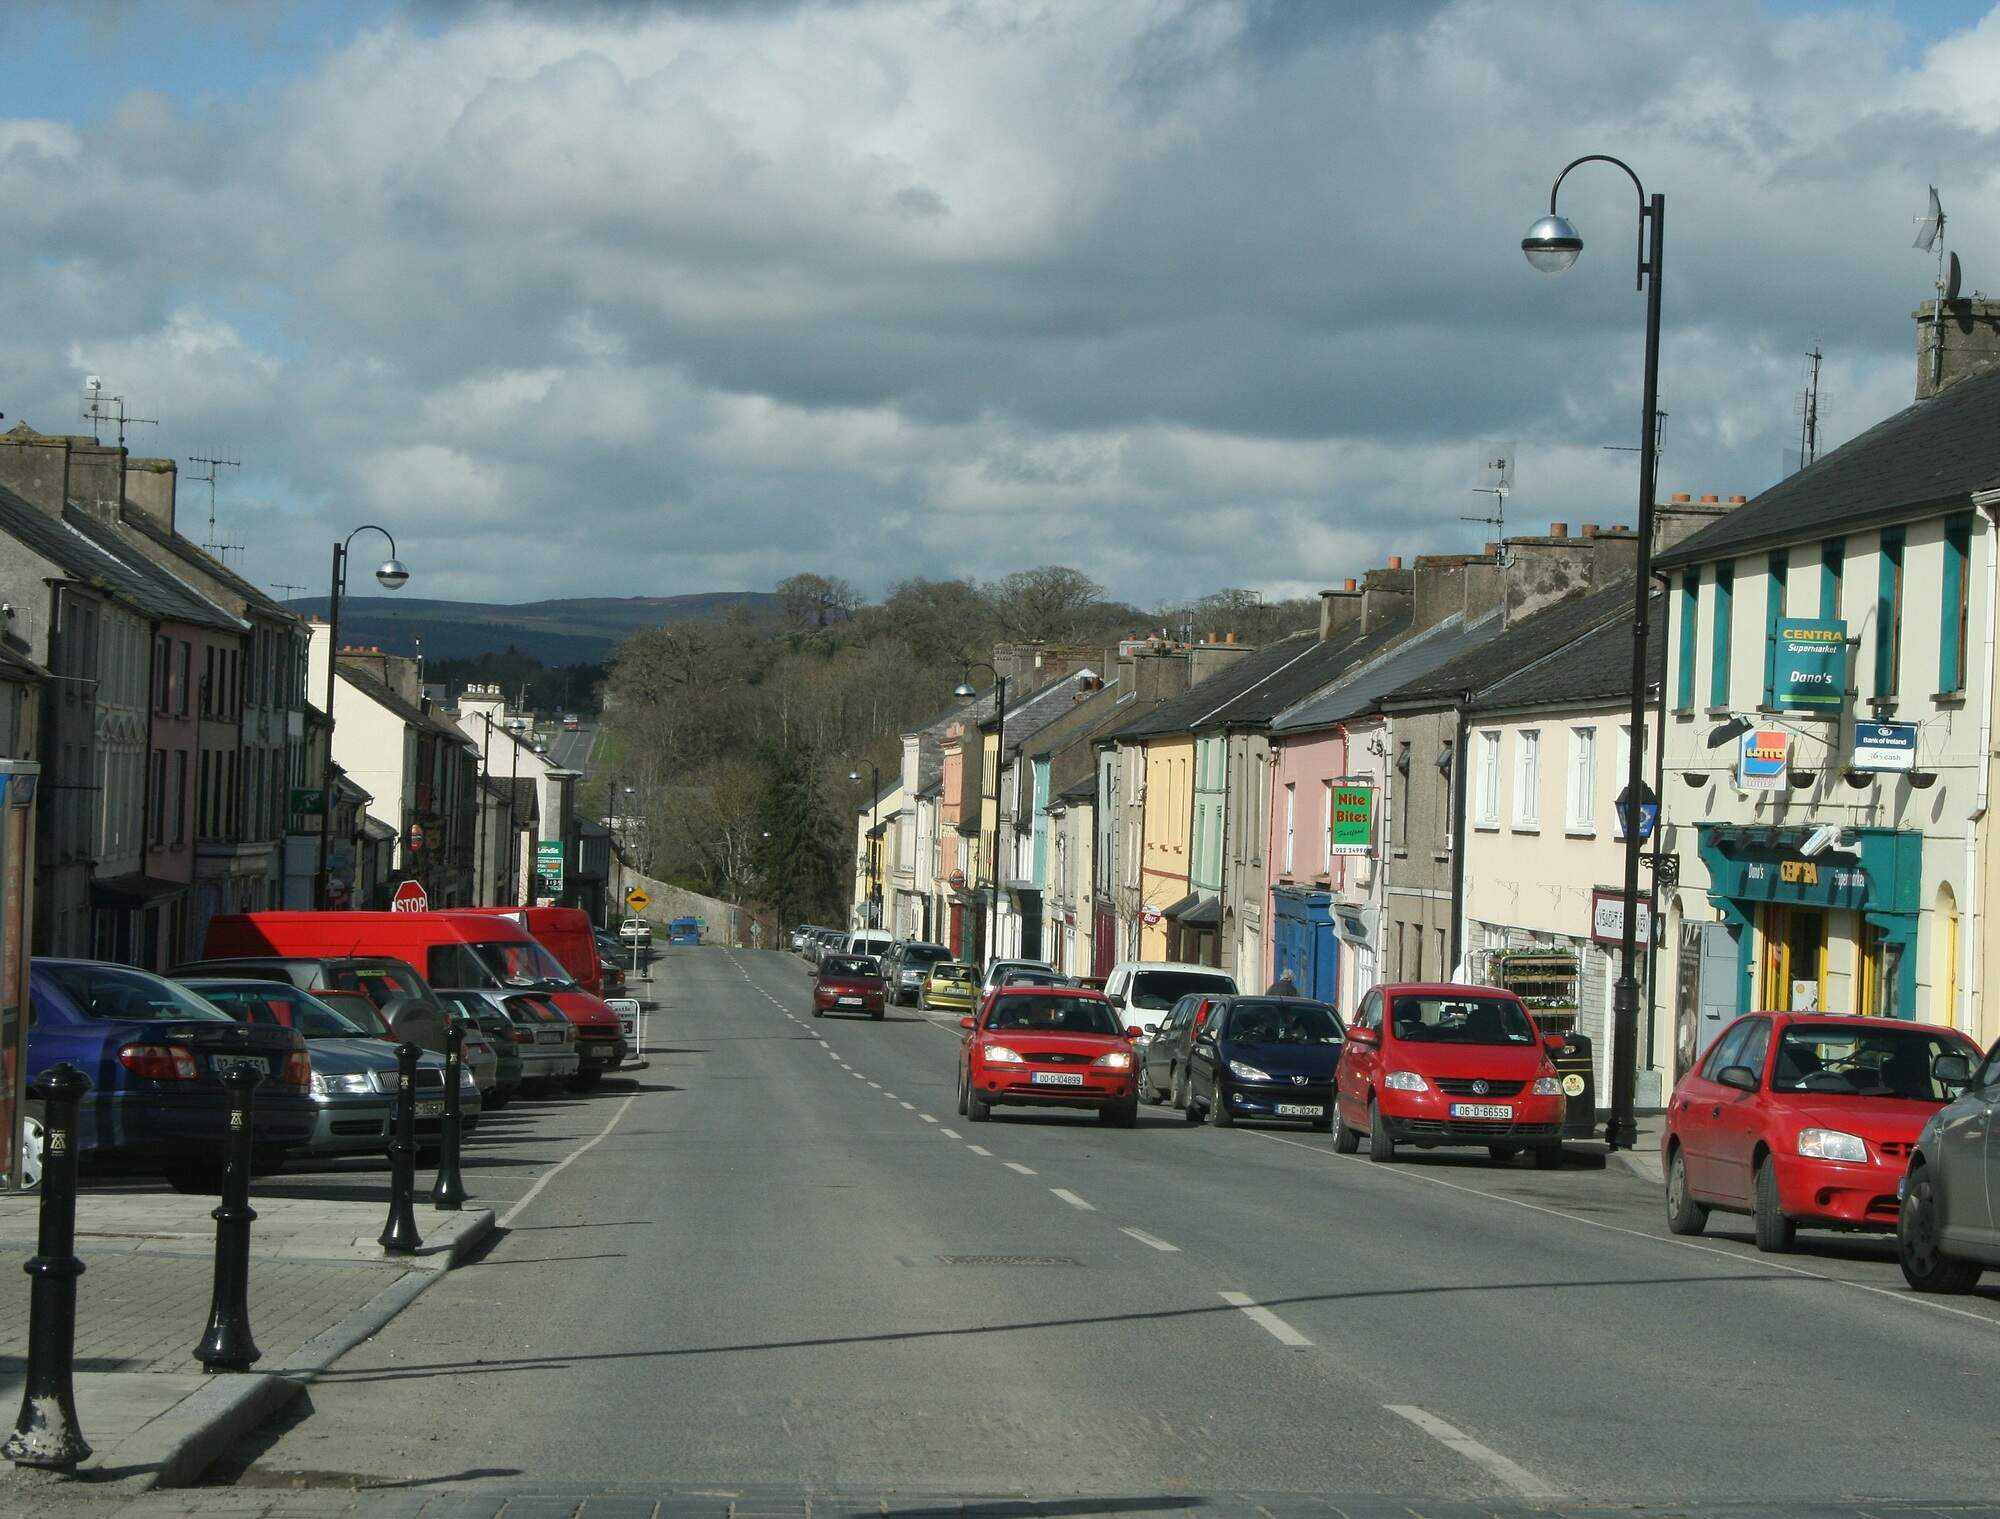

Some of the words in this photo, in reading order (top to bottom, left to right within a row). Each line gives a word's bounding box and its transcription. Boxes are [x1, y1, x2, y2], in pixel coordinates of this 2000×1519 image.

[1782, 629, 1843, 641] CENTRA
[1788, 643, 1837, 654] Supermarket
[1790, 670, 1832, 684] Dano's
[1863, 736, 1878, 744] Bank
[1746, 748, 1784, 759] LOTTO
[1338, 794, 1366, 806] Nite
[1336, 811, 1368, 822] Bites
[396, 897, 426, 912] STOP
[1460, 1106, 1509, 1118] 06-D-66559
